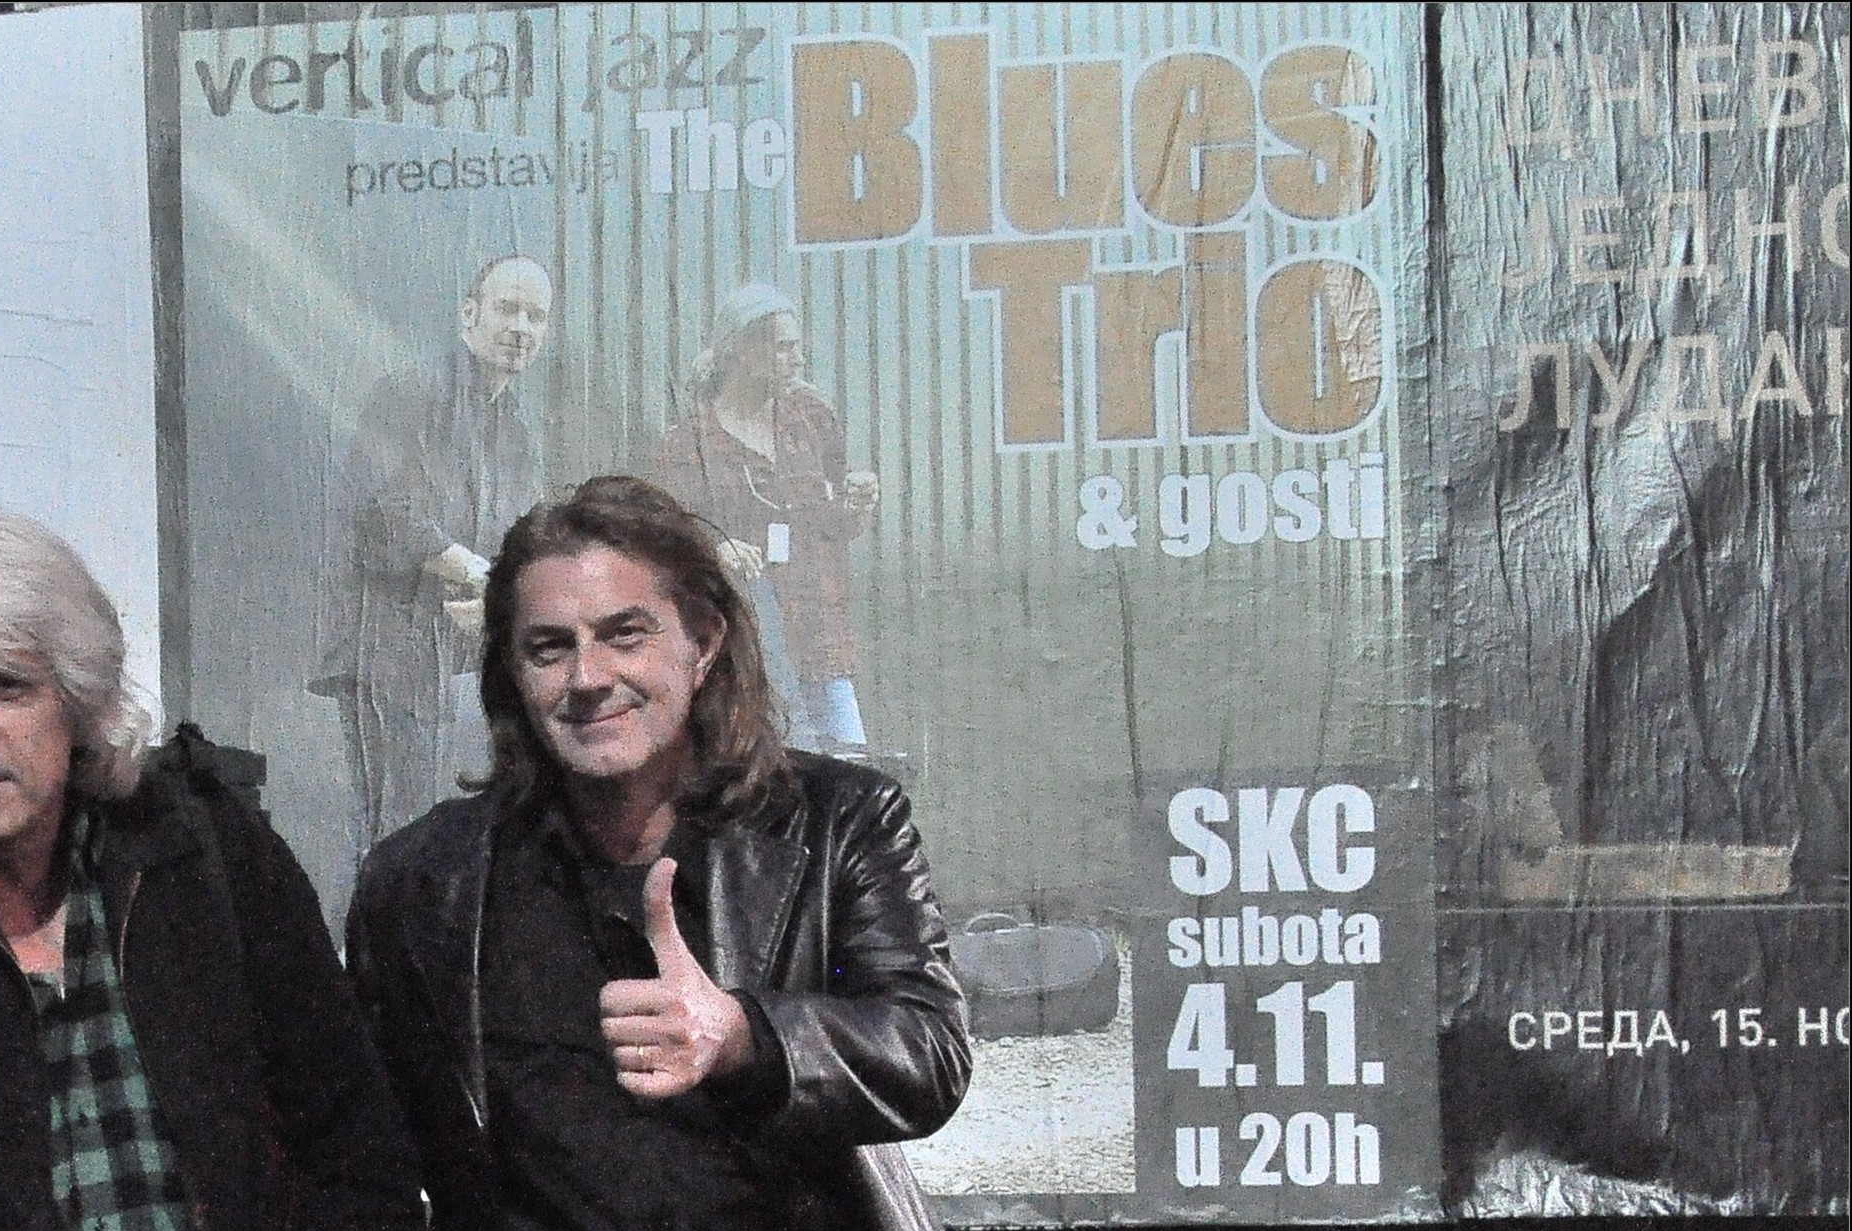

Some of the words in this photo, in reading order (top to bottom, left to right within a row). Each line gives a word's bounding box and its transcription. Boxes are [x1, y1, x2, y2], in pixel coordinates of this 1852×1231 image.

[194, 9, 534, 116] vertical
[580, 27, 767, 113] jazz
[1494, 34, 1849, 161] ДНЕВ
[347, 140, 619, 206] predstavlja
[634, 107, 788, 194] The
[788, 28, 1388, 250] Blues
[963, 228, 1396, 451] Trio
[1499, 327, 1849, 441] ЛУДА
[1077, 474, 1138, 551] &
[1159, 454, 1385, 558] gosti
[1167, 784, 1377, 896] SKC
[1167, 906, 1382, 968] subota
[1166, 980, 1384, 1088] 4.11.
[1508, 1009, 1691, 1057] СРЕДА,
[1711, 1007, 1777, 1047] 15.
[1174, 1126, 1221, 1187] u
[1239, 1111, 1381, 1187] 20h
